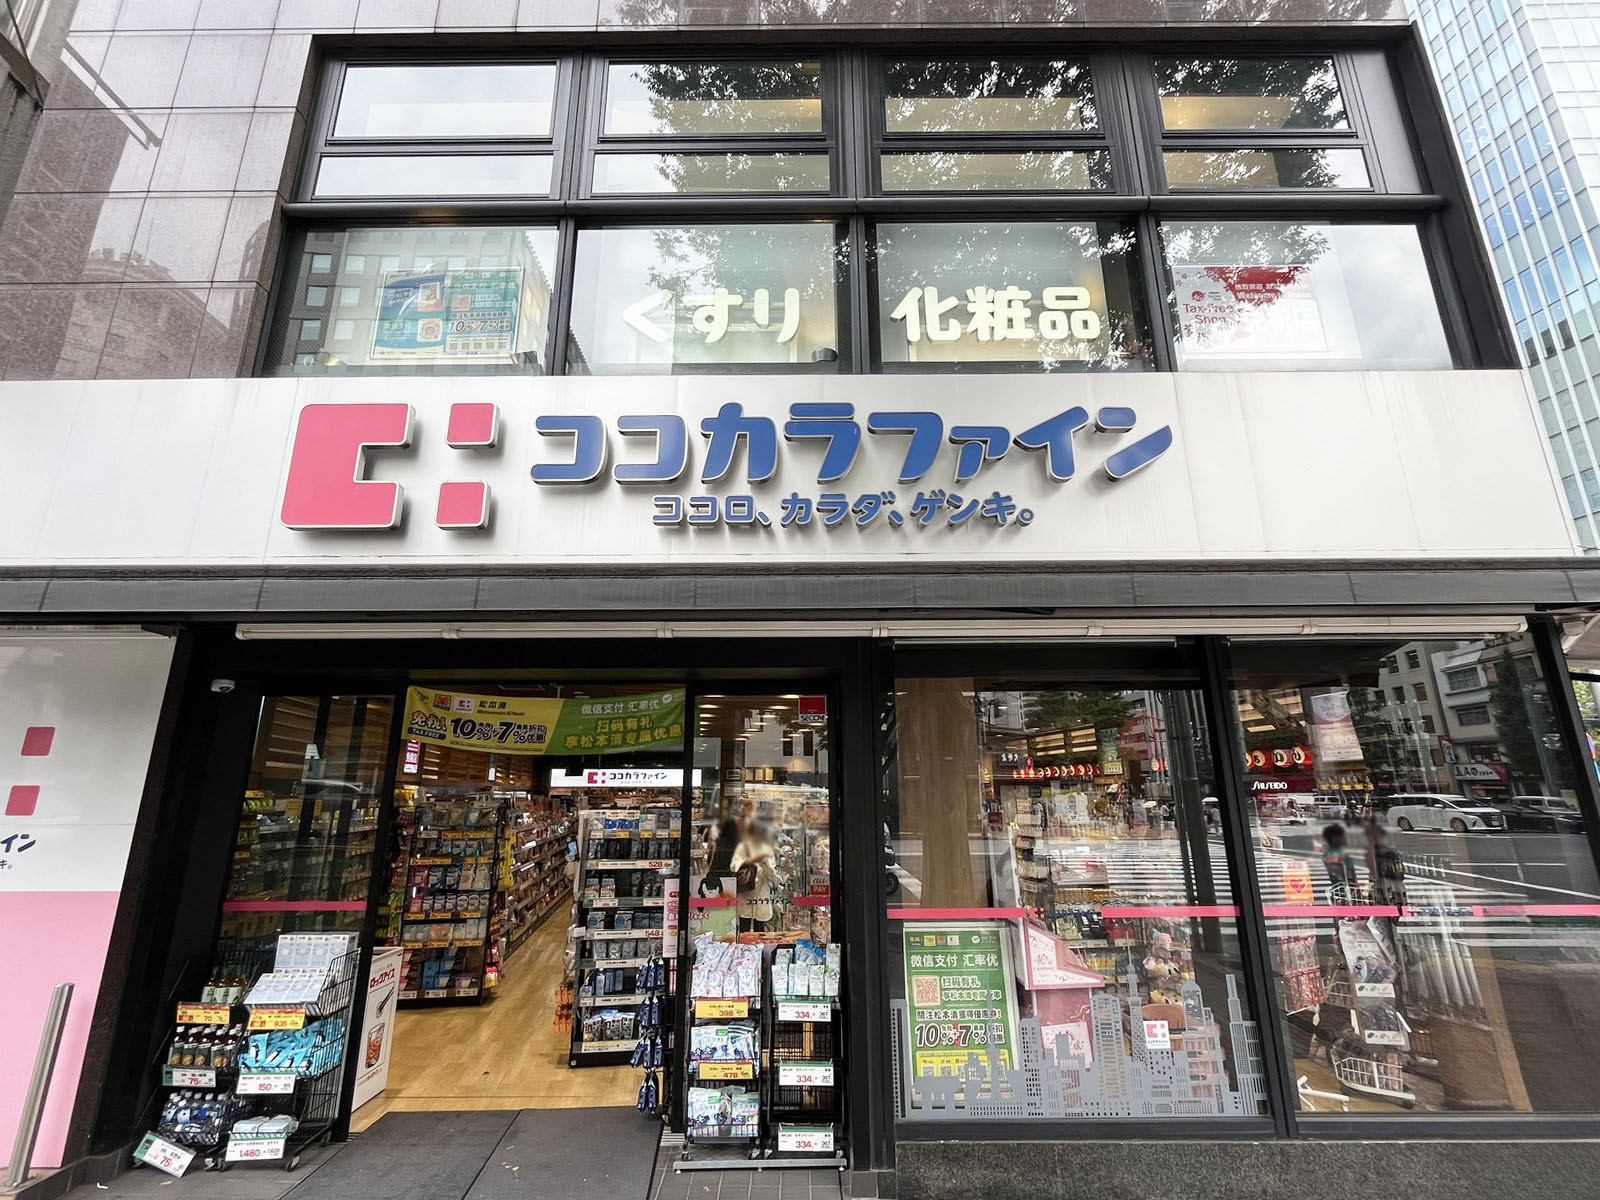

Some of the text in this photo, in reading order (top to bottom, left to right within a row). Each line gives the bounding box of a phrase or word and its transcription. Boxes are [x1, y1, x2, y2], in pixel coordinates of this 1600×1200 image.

[621, 287, 801, 345] くすり
[890, 286, 1101, 343] 化粧品
[530, 402, 1173, 485] ココカラファイン
[652, 490, 1035, 528] ココロ、カラダ、ゲンキ。
[581, 702, 624, 715] 微信支付
[596, 716, 653, 733] 扫码有礼
[609, 772, 667, 781] ココカラファイン
[910, 953, 999, 968] 微信支付 汇率优
[941, 976, 981, 988] 扫码有礼
[796, 1075, 812, 1083] 334
[796, 1141, 812, 1149] 334
